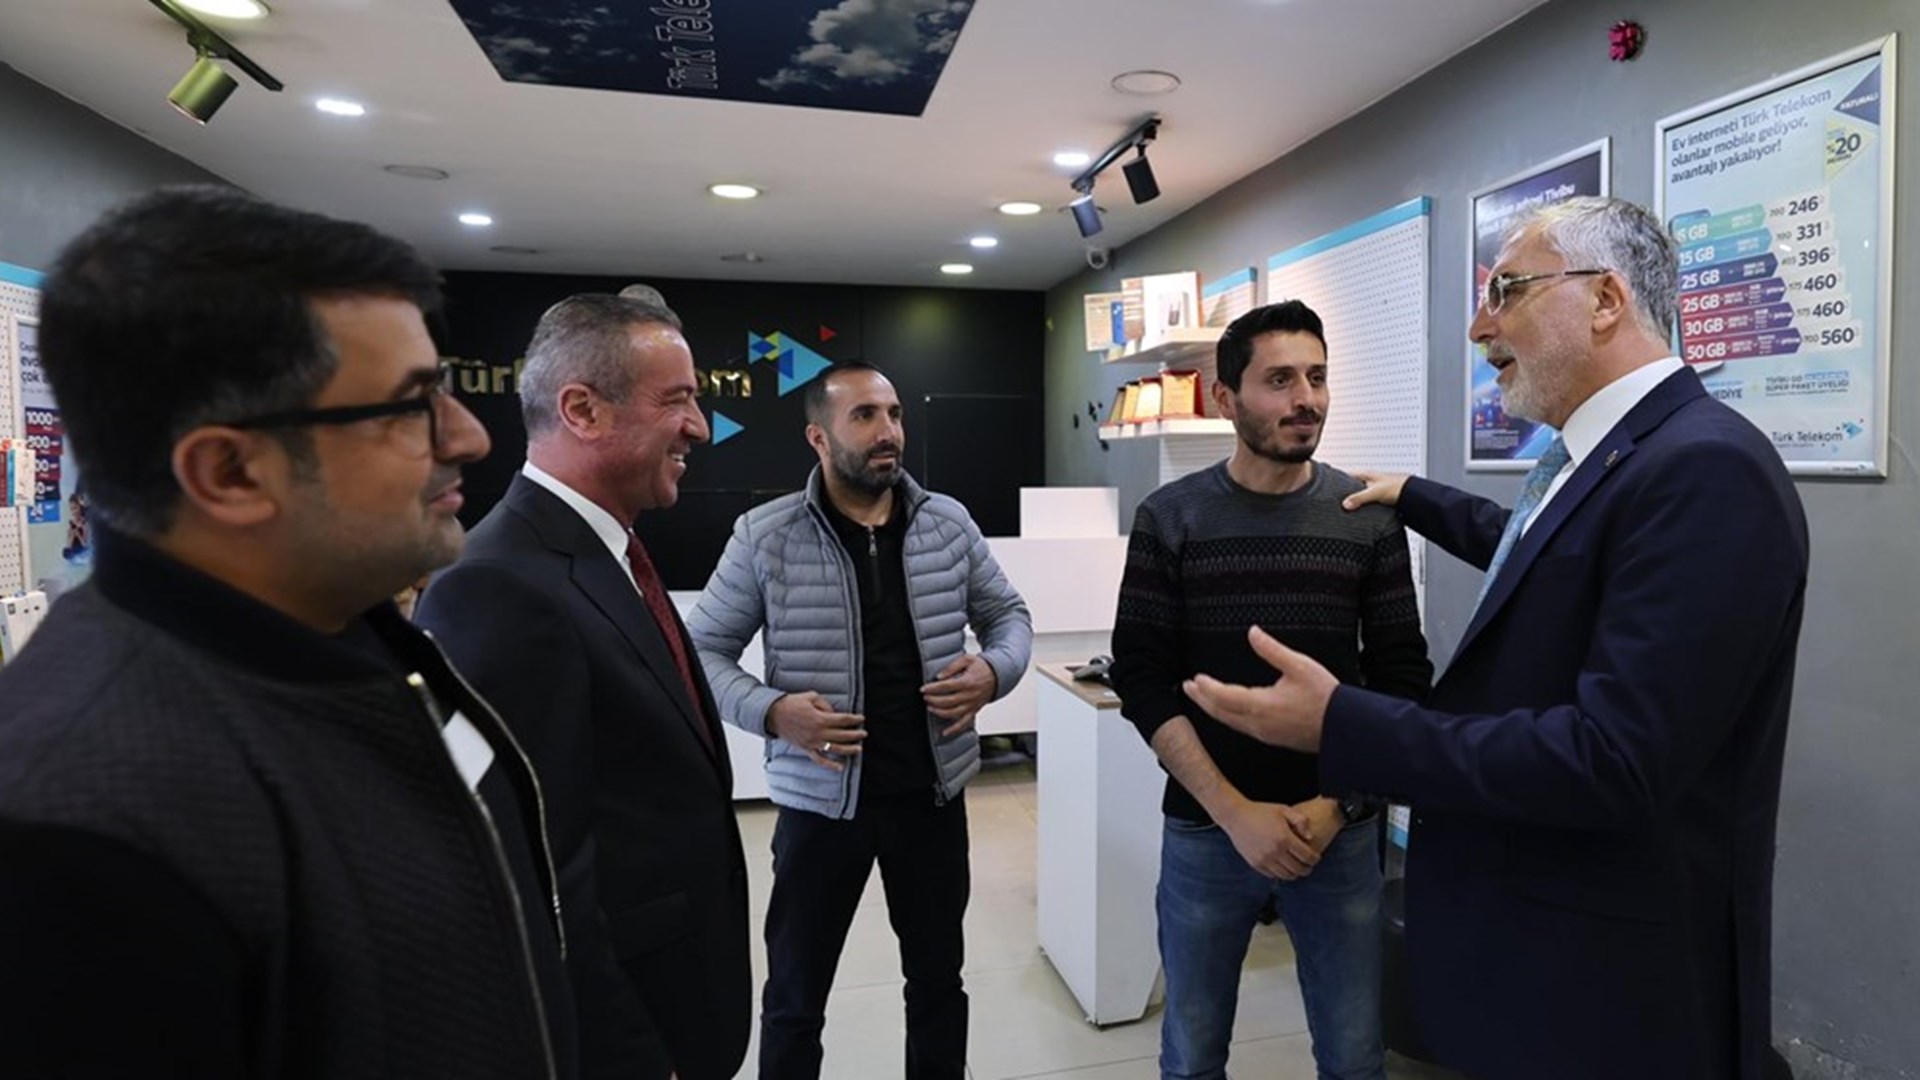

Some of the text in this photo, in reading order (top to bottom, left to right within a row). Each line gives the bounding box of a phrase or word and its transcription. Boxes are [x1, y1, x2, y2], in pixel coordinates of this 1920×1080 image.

[661, 46, 718, 89] Türk
[1671, 146, 1712, 168] olanlar
[1714, 130, 1756, 153] mobile
[1758, 115, 1808, 142] geliyor,
[1672, 89, 1832, 152] Ev interneti Türk Telekom
[1671, 139, 1782, 184] avantajı yakalıyor!
[1688, 222, 1709, 241] GB
[1788, 195, 1819, 216] 246
[1679, 249, 1693, 267] 15
[1695, 245, 1715, 263] GB
[1796, 221, 1822, 241] 331
[1681, 272, 1698, 290] 25
[1700, 268, 1720, 287] GB
[1798, 246, 1830, 267] 396
[1682, 296, 1699, 314] 25
[1700, 293, 1720, 311] GB
[1804, 273, 1837, 292] 460
[1684, 320, 1702, 338] 30
[1703, 317, 1724, 334] GB
[1812, 300, 1845, 317] 460
[1686, 344, 1705, 361] 50
[1706, 341, 1726, 359] GB
[1821, 327, 1855, 346] 560
[1791, 381, 1816, 390] PAKET
[26, 411, 54, 425] 1000
[1772, 431, 1843, 443] Türk Telekom
